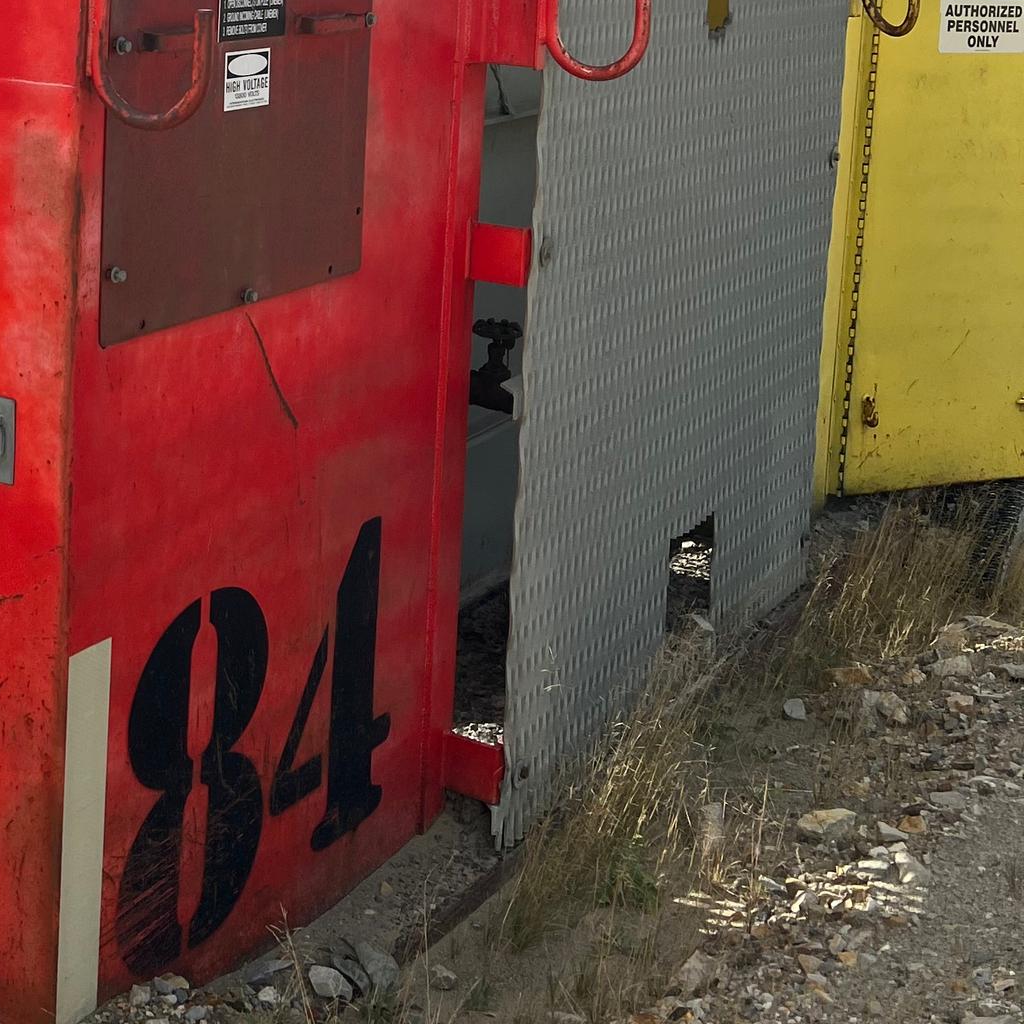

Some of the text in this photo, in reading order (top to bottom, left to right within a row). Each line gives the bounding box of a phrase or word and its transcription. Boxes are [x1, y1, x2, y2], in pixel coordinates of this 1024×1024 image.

[945, 4, 1023, 18] AUTHORIZED
[947, 20, 1019, 33] PERSONNEL
[967, 35, 999, 48] ONLY
[226, 77, 268, 93] HIGH VOLTAGE
[117, 517, 391, 975] 84
